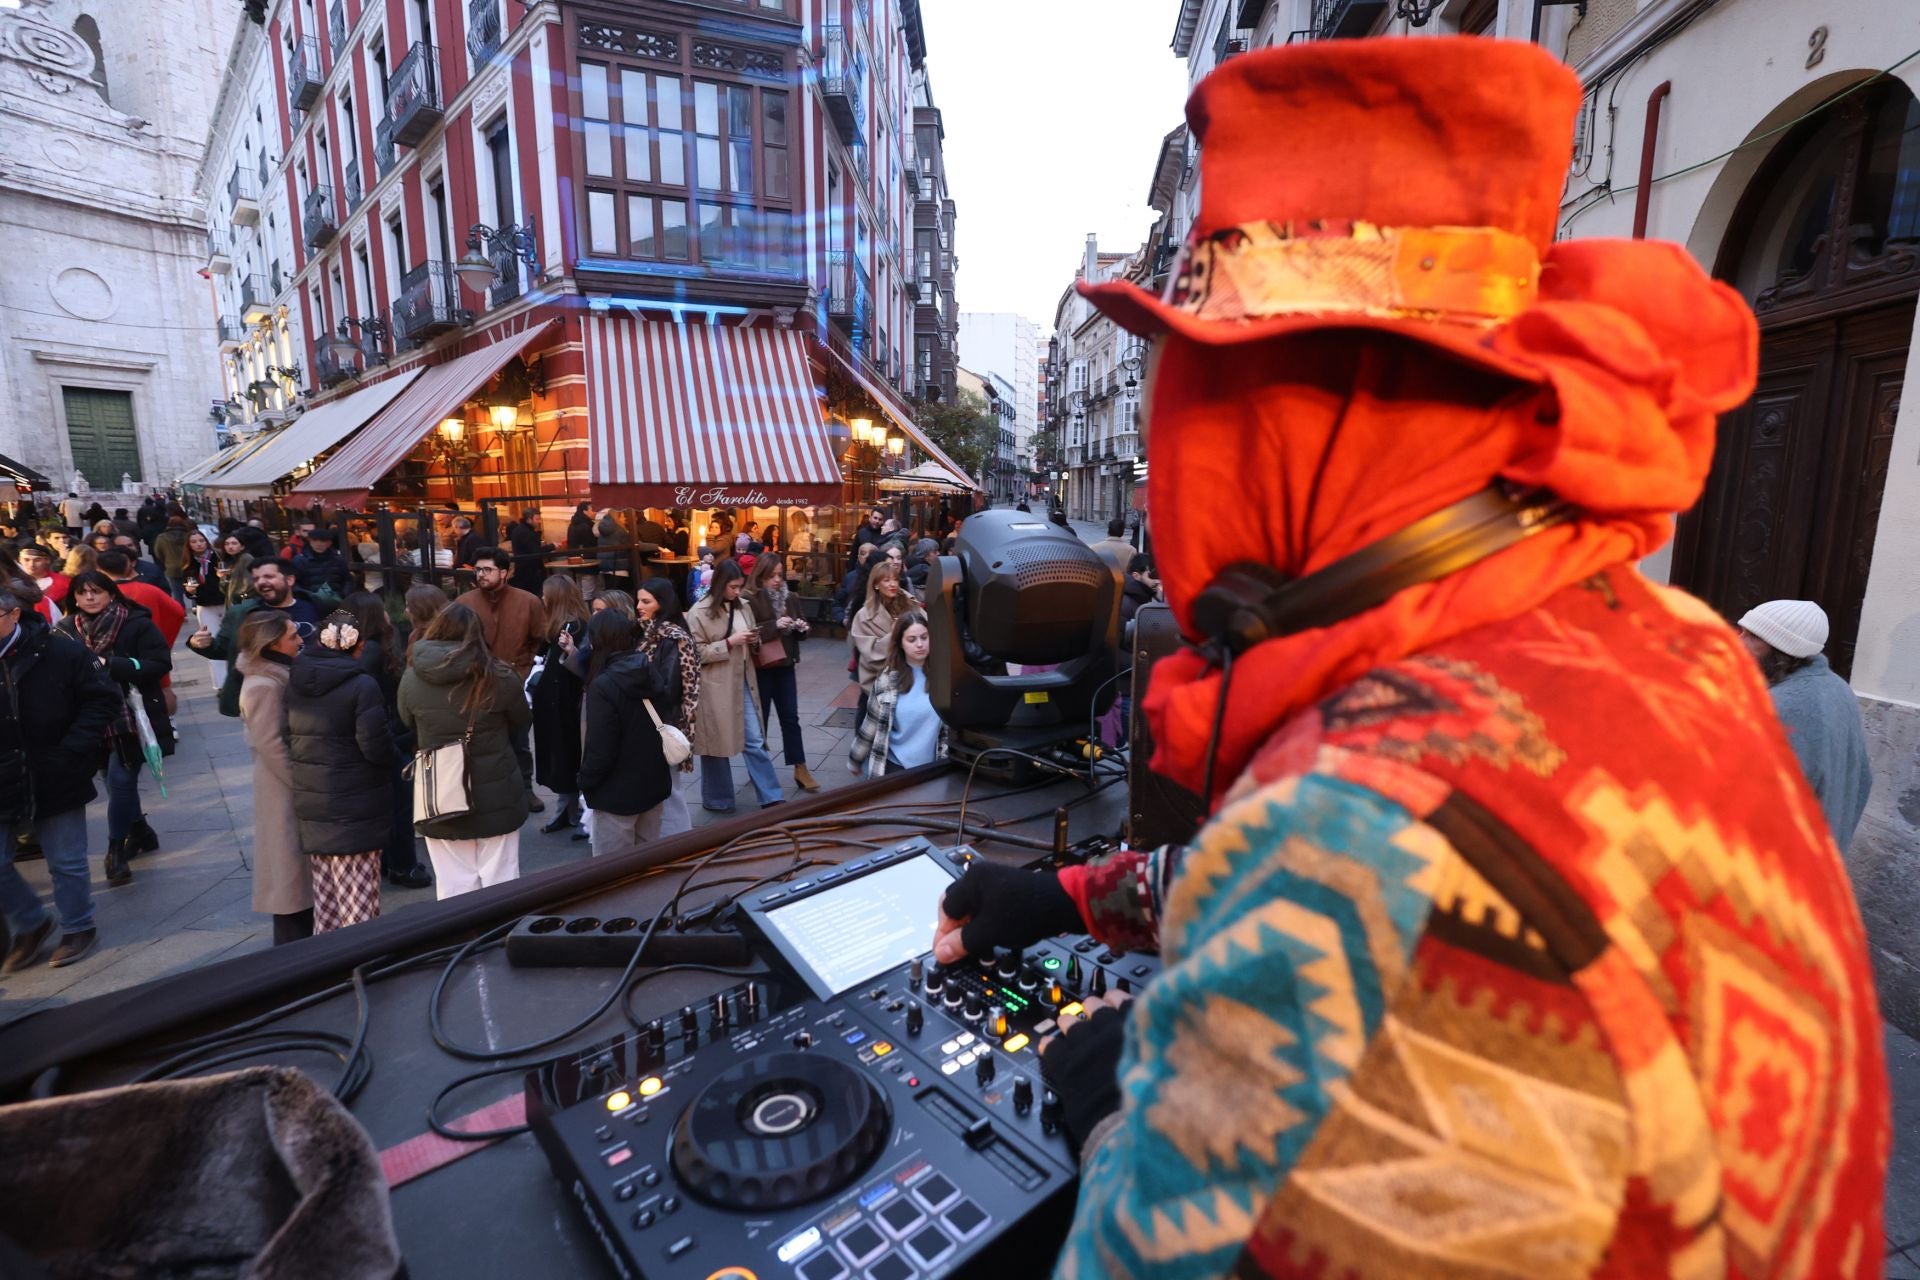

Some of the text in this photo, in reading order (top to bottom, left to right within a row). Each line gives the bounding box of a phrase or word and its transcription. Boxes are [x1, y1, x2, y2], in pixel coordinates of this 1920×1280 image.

[1804, 25, 1828, 70] 2
[674, 486, 697, 506] El
[699, 487, 769, 505] Farolito
[776, 497, 794, 505] desde
